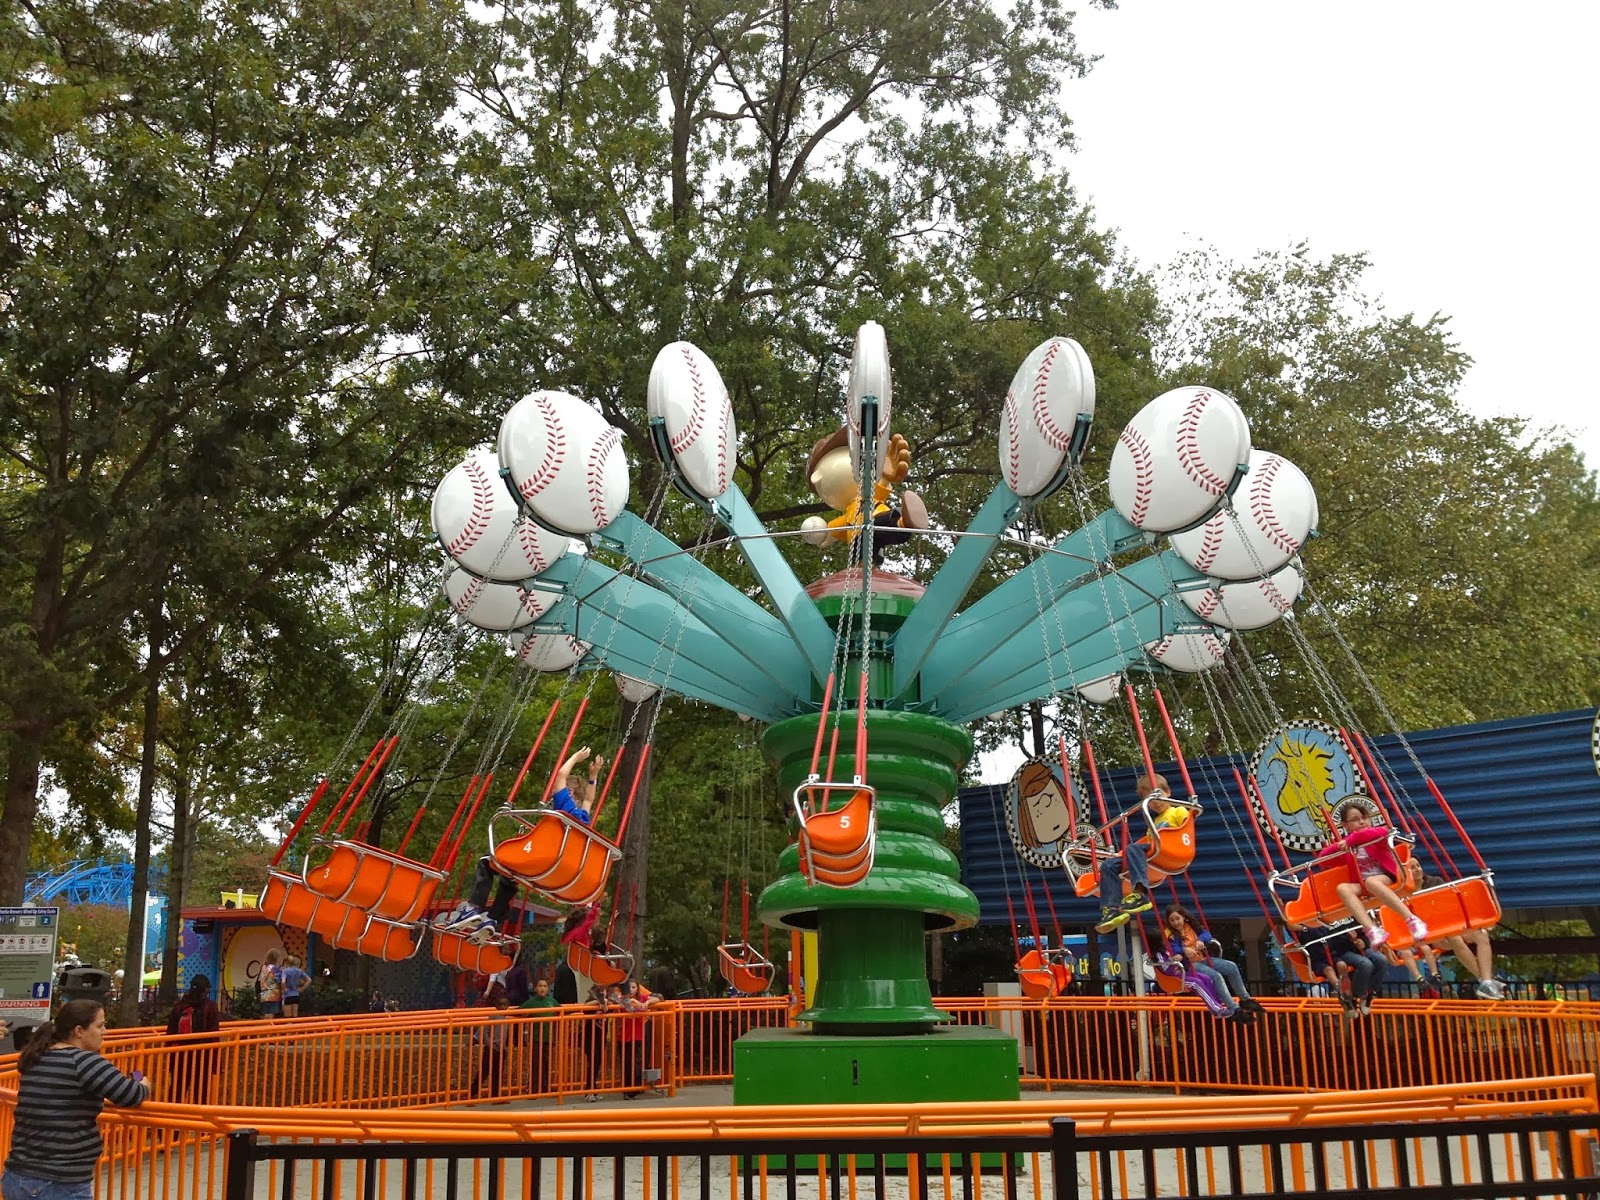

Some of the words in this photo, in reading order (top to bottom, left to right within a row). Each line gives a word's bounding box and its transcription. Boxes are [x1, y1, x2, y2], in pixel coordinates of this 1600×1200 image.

[840, 815, 850, 829] 5
[1181, 833, 1191, 846] 6
[522, 840, 533, 854] 4
[323, 867, 330, 879] 3
